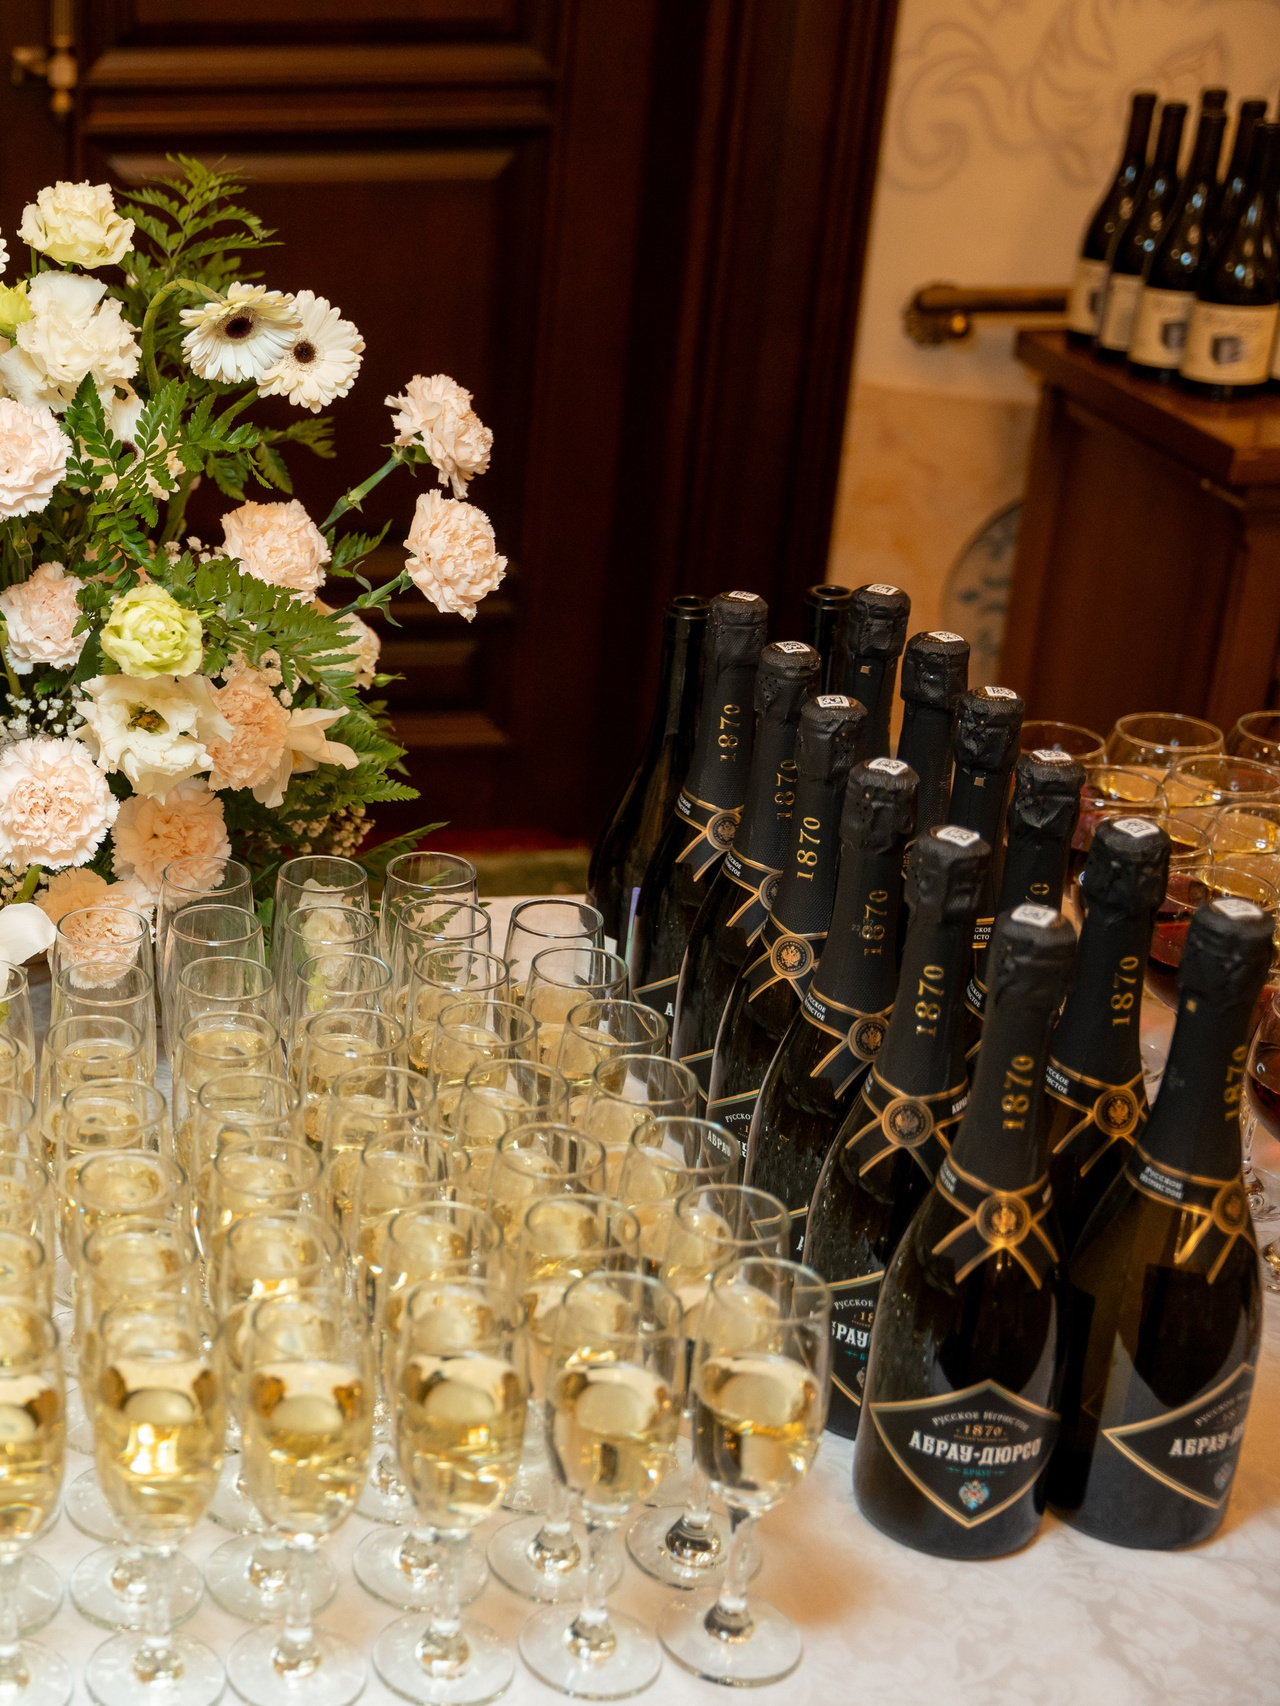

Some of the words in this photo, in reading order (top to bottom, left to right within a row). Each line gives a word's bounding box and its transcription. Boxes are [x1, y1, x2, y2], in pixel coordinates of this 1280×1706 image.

[718, 704, 740, 761] 1870
[774, 760, 797, 819] 1870
[797, 817, 820, 881] 1870
[861, 890, 888, 957] 1870
[915, 964, 944, 1037] 1870
[1111, 956, 1139, 1027] 1870
[725, 1112, 754, 1123] РУССКО
[1001, 1055, 1035, 1131] 1870
[834, 1299, 873, 1310] РУССКОЕ
[932, 1411, 979, 1426] РУССКОЕ
[964, 1424, 1003, 1437] 1870
[908, 1430, 1042, 1466] АБРАУ-ДЮРСО
